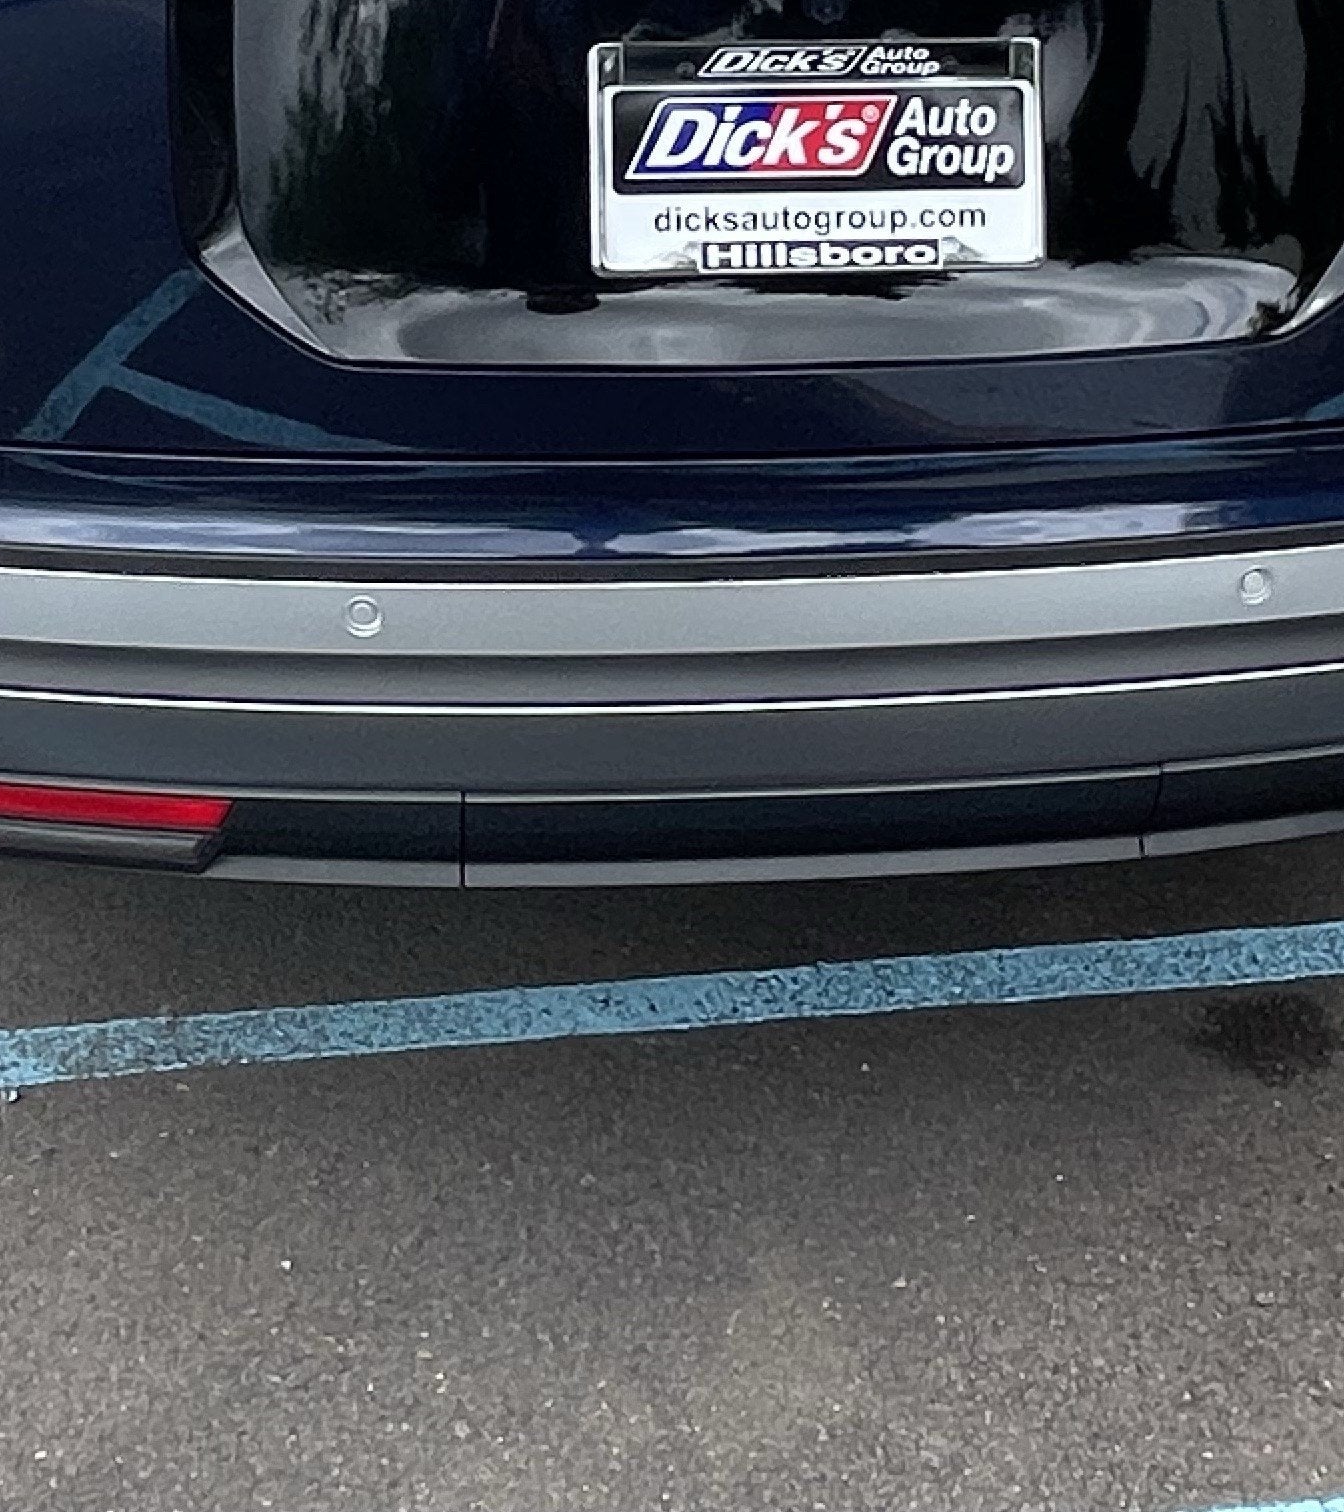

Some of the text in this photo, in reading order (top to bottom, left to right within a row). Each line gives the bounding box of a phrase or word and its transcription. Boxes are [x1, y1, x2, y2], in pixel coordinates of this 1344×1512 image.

[860, 60, 940, 76] Group
[865, 46, 931, 61] Auto
[894, 96, 998, 137] Auto
[886, 136, 1016, 182] Group
[654, 205, 987, 236] dicksautogroup.com
[705, 242, 937, 269] Hillsboro
